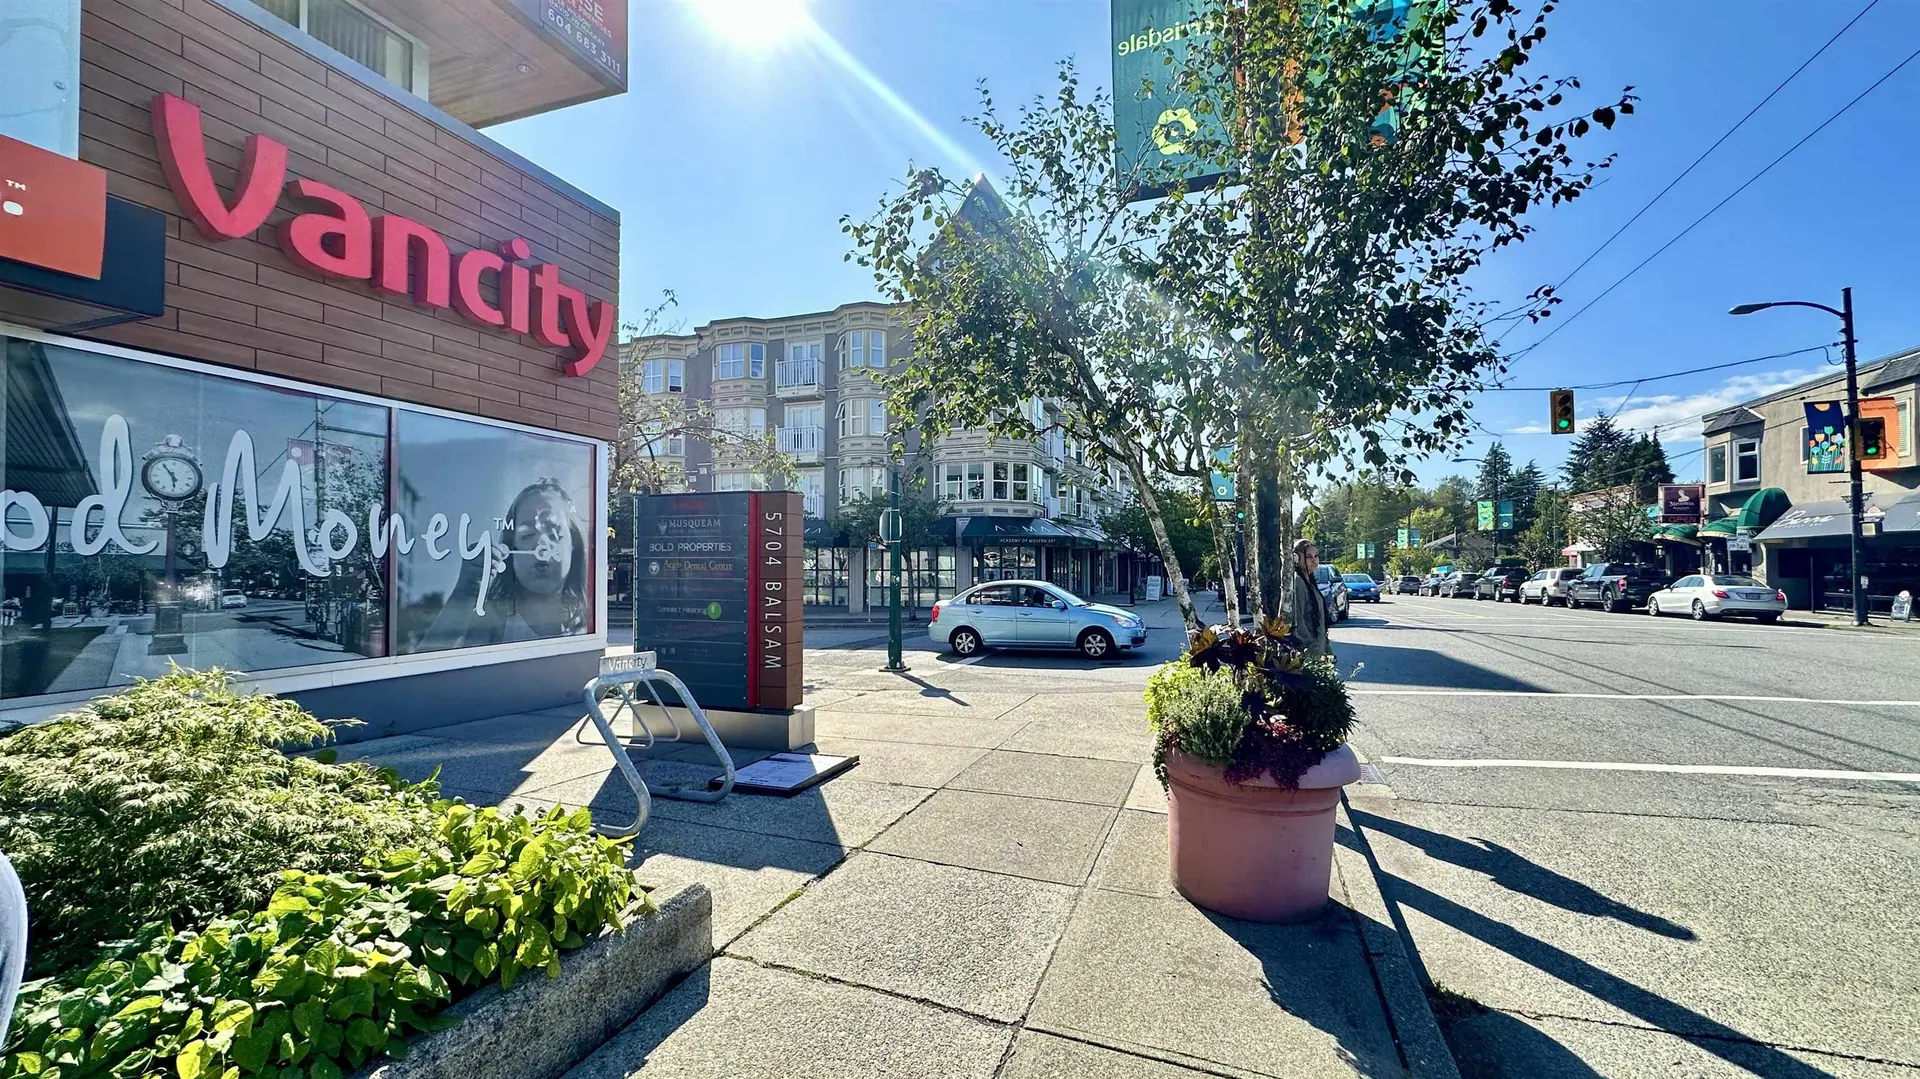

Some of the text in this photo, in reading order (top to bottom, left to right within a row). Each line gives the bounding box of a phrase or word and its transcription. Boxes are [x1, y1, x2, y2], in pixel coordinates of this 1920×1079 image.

[579, 4, 612, 38] PREMISES
[547, 8, 621, 74] 604 683 3111
[151, 92, 615, 378] Vancity
[204, 429, 498, 617] Money
[668, 519, 721, 529] MUSQUEAM
[649, 542, 732, 552] BOLD PROPERTIES
[684, 560, 707, 570] Dental
[708, 560, 734, 571] Centre
[764, 512, 782, 670] 5704 BALSAM
[656, 605, 708, 616] Connect Hearing
[608, 656, 647, 672] Vancity
